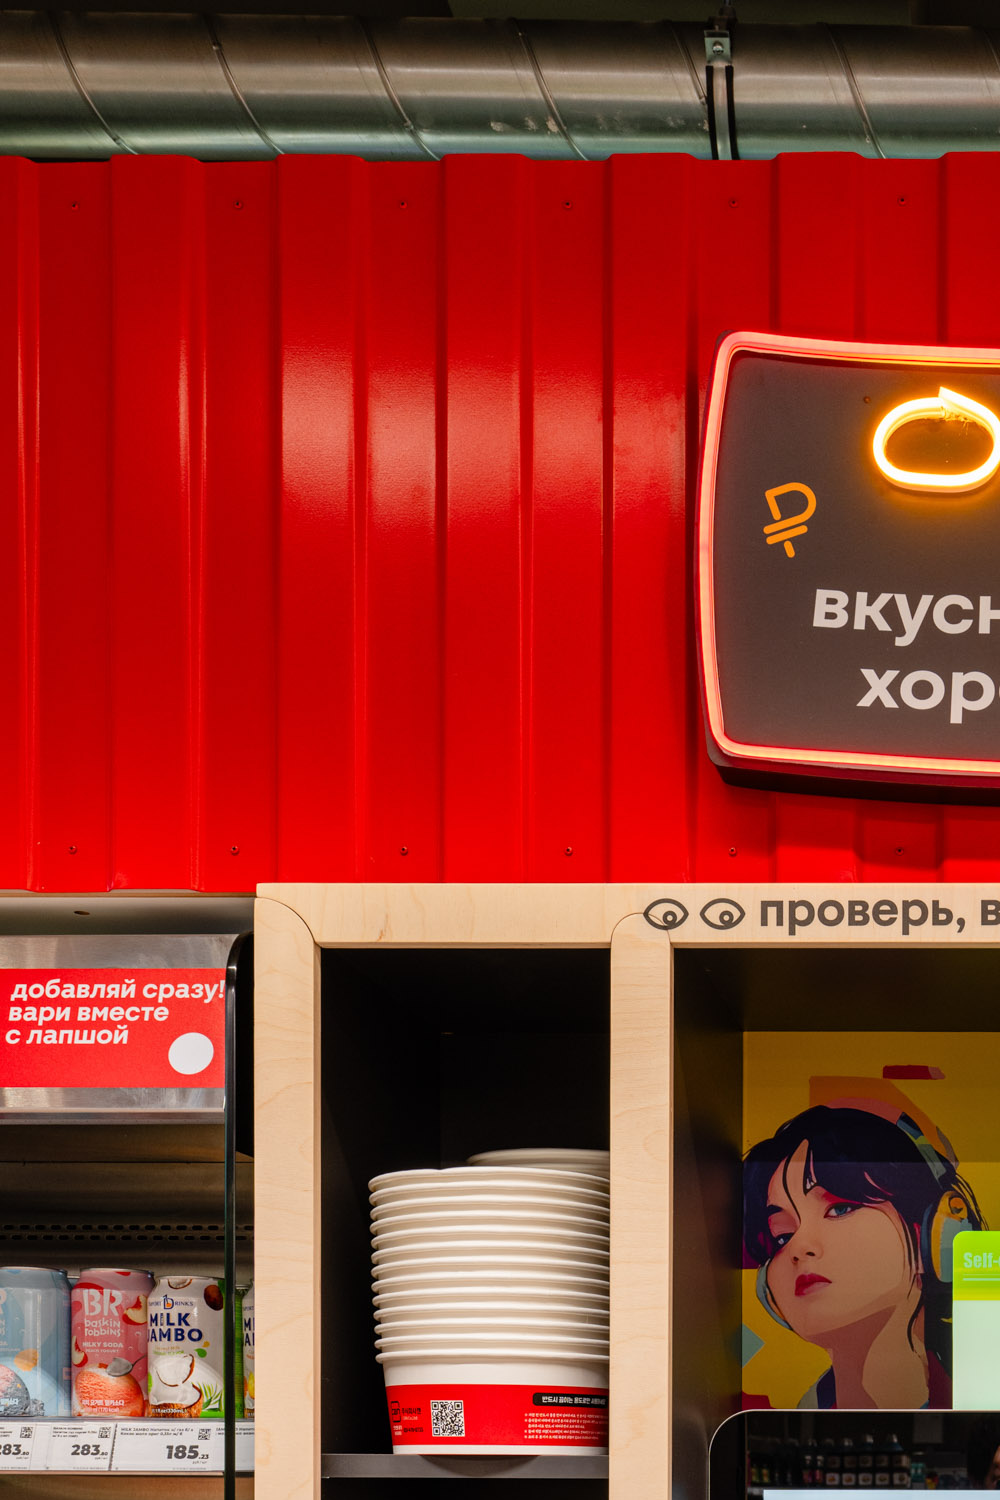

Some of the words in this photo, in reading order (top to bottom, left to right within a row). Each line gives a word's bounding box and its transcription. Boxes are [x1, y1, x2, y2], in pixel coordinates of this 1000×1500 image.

[760, 894, 968, 937] проверь,
[10, 979, 136, 1001] добавляй
[143, 980, 226, 1003] сразу!
[9, 1006, 70, 1026] вари
[77, 1006, 170, 1022] вместе
[5, 1029, 21, 1044] с
[26, 1025, 130, 1045] лапшой
[83, 1289, 123, 1317] BR
[150, 1313, 191, 1327] MILK
[0, 1444, 30, 1456] 83.80
